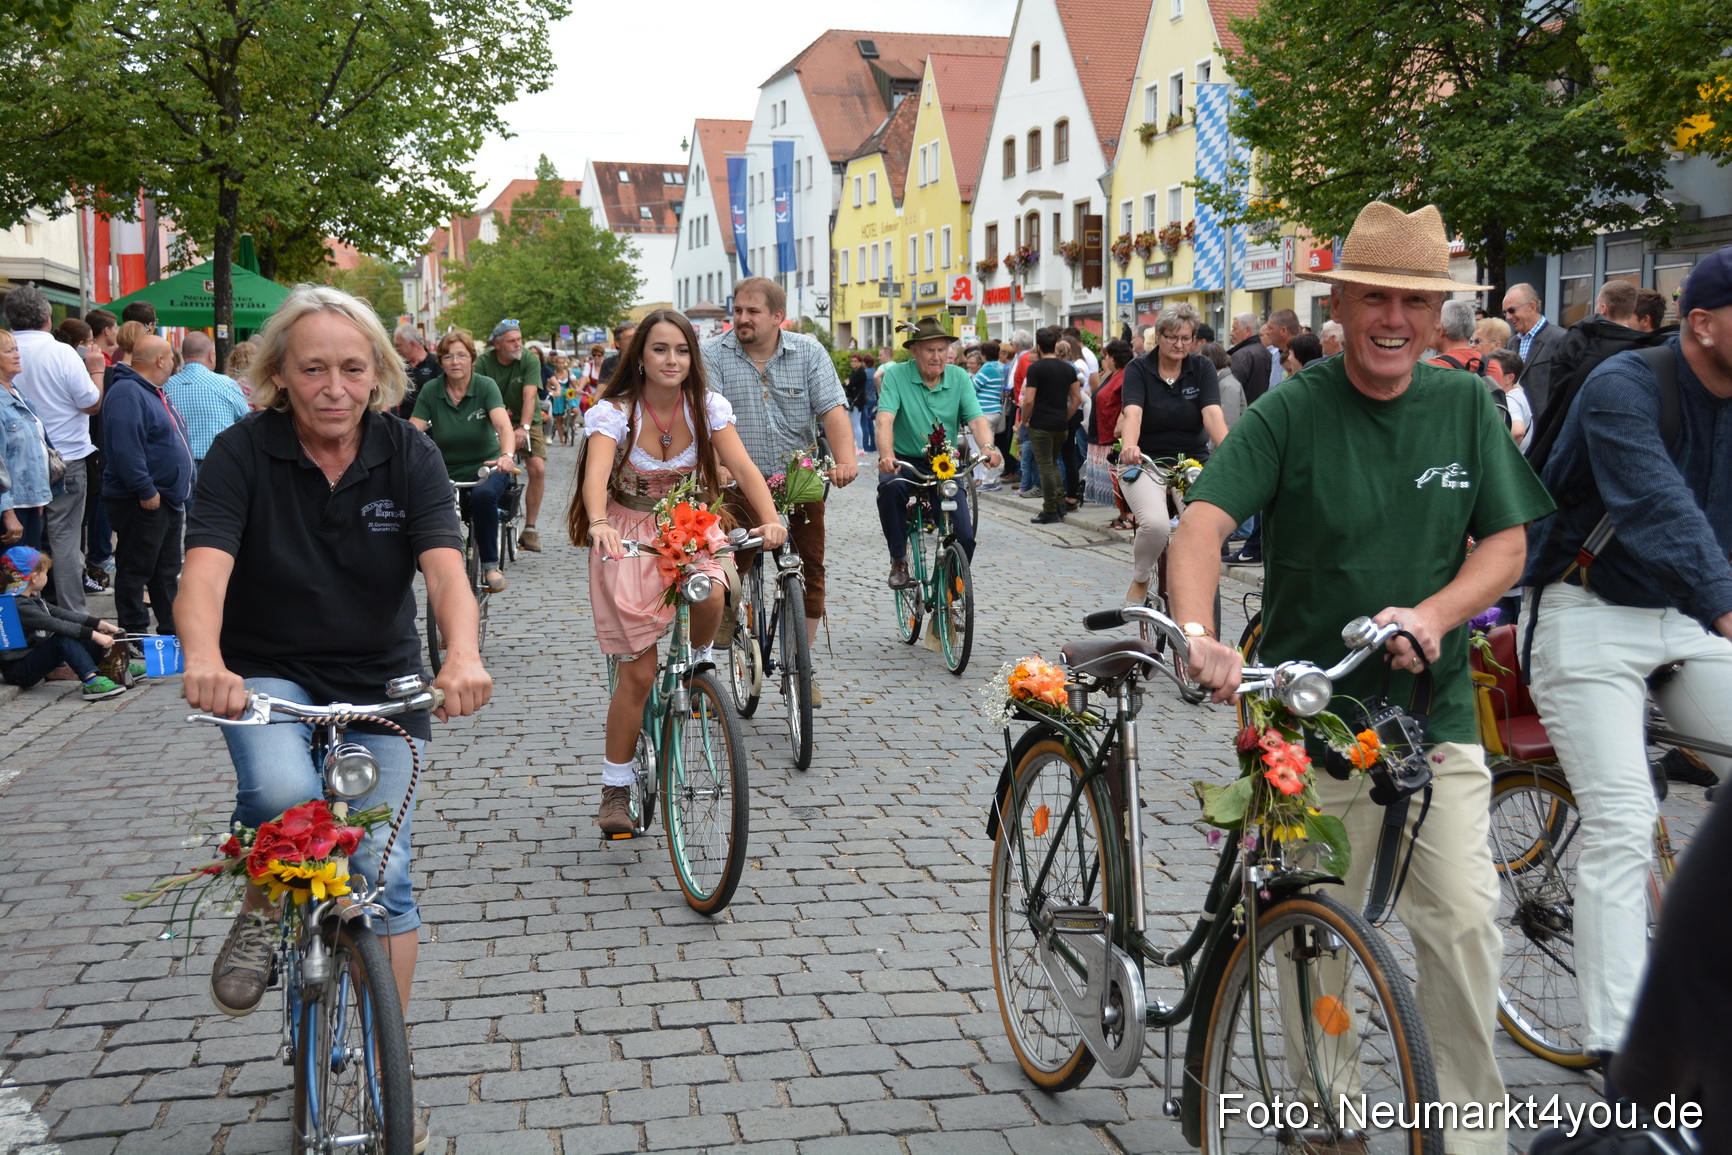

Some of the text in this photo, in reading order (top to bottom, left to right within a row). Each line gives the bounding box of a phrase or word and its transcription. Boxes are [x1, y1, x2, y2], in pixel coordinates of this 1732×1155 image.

[861, 222, 878, 239] HOTEL
[1285, 238, 1293, 284] KINO
[1120, 281, 1130, 302] P
